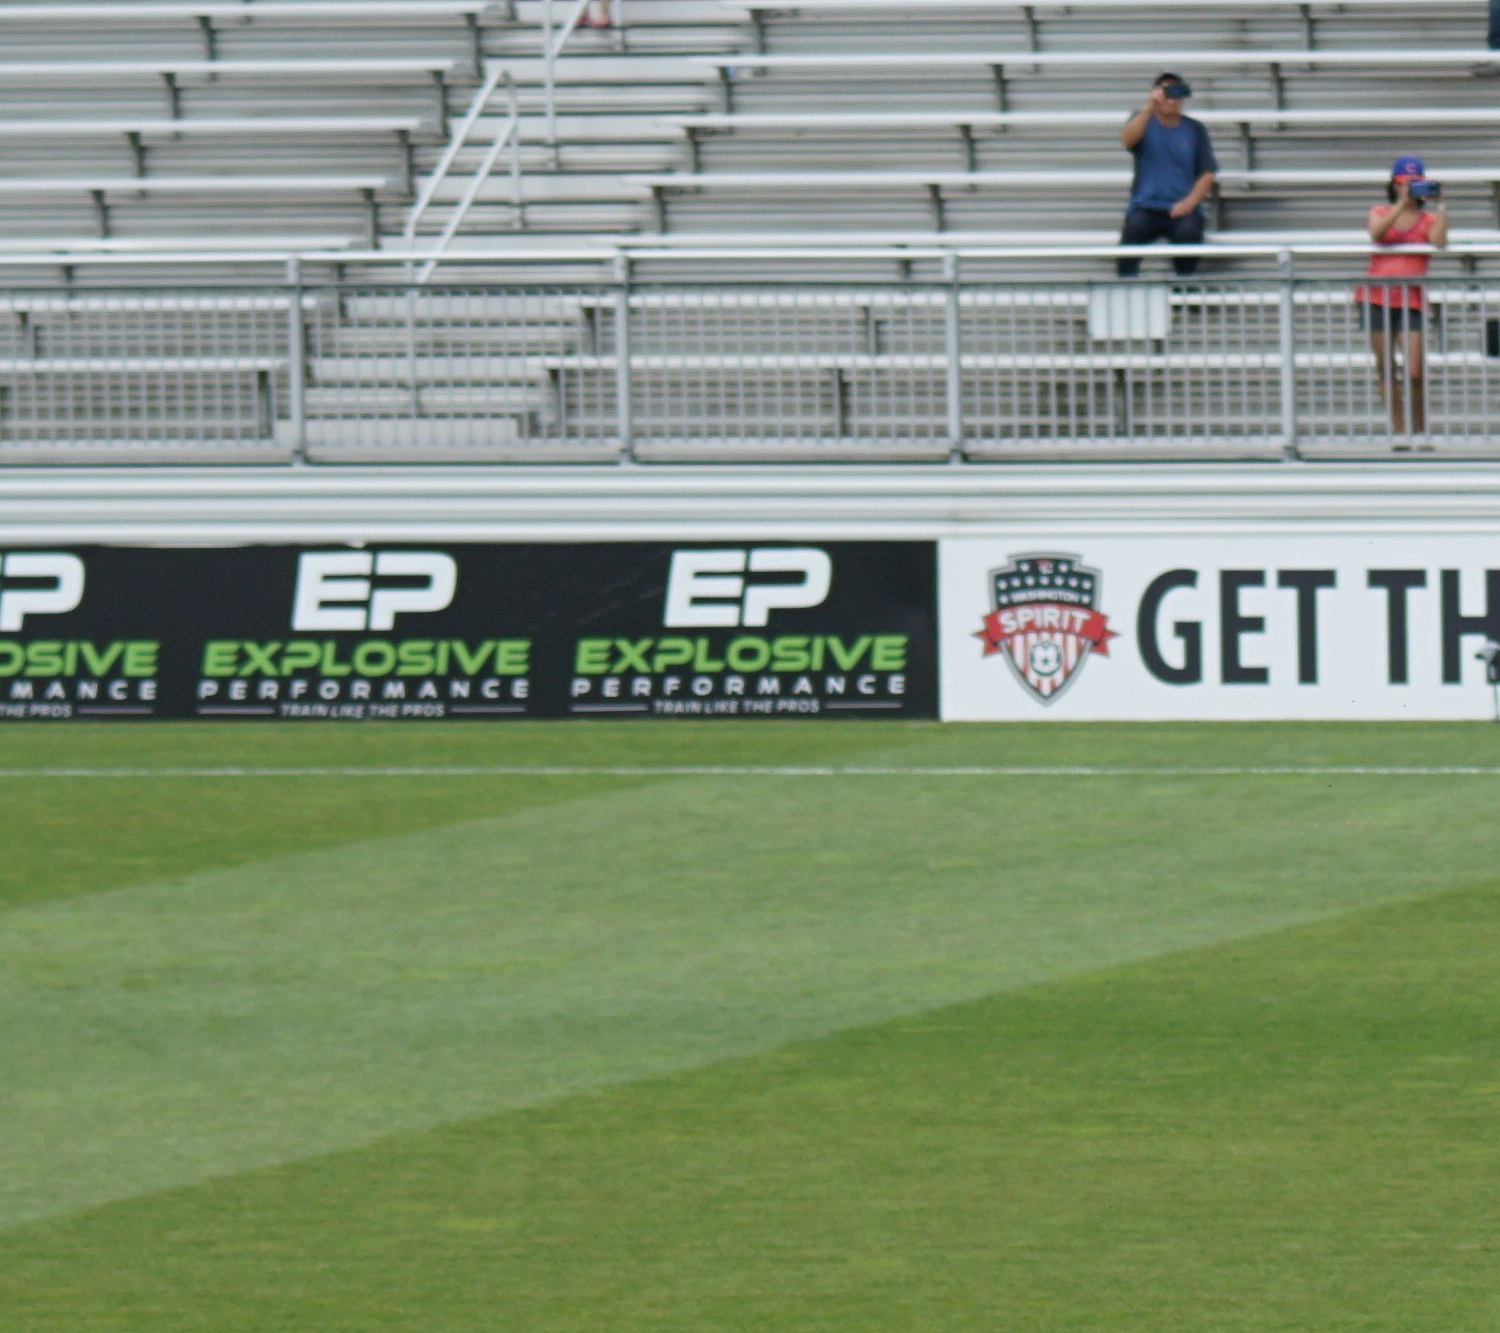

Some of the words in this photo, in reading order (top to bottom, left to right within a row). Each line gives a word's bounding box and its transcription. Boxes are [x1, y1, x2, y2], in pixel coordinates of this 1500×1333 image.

[292, 551, 458, 631] EP
[663, 548, 833, 628] EP
[998, 606, 1092, 634] SPIRIT
[1136, 568, 1336, 686] GET
[202, 640, 532, 676] EXPLOSIVE
[575, 636, 909, 674] EXPLOSIVE
[197, 679, 530, 700] PERFORMANCE
[571, 675, 906, 697] PERFORMANCE
